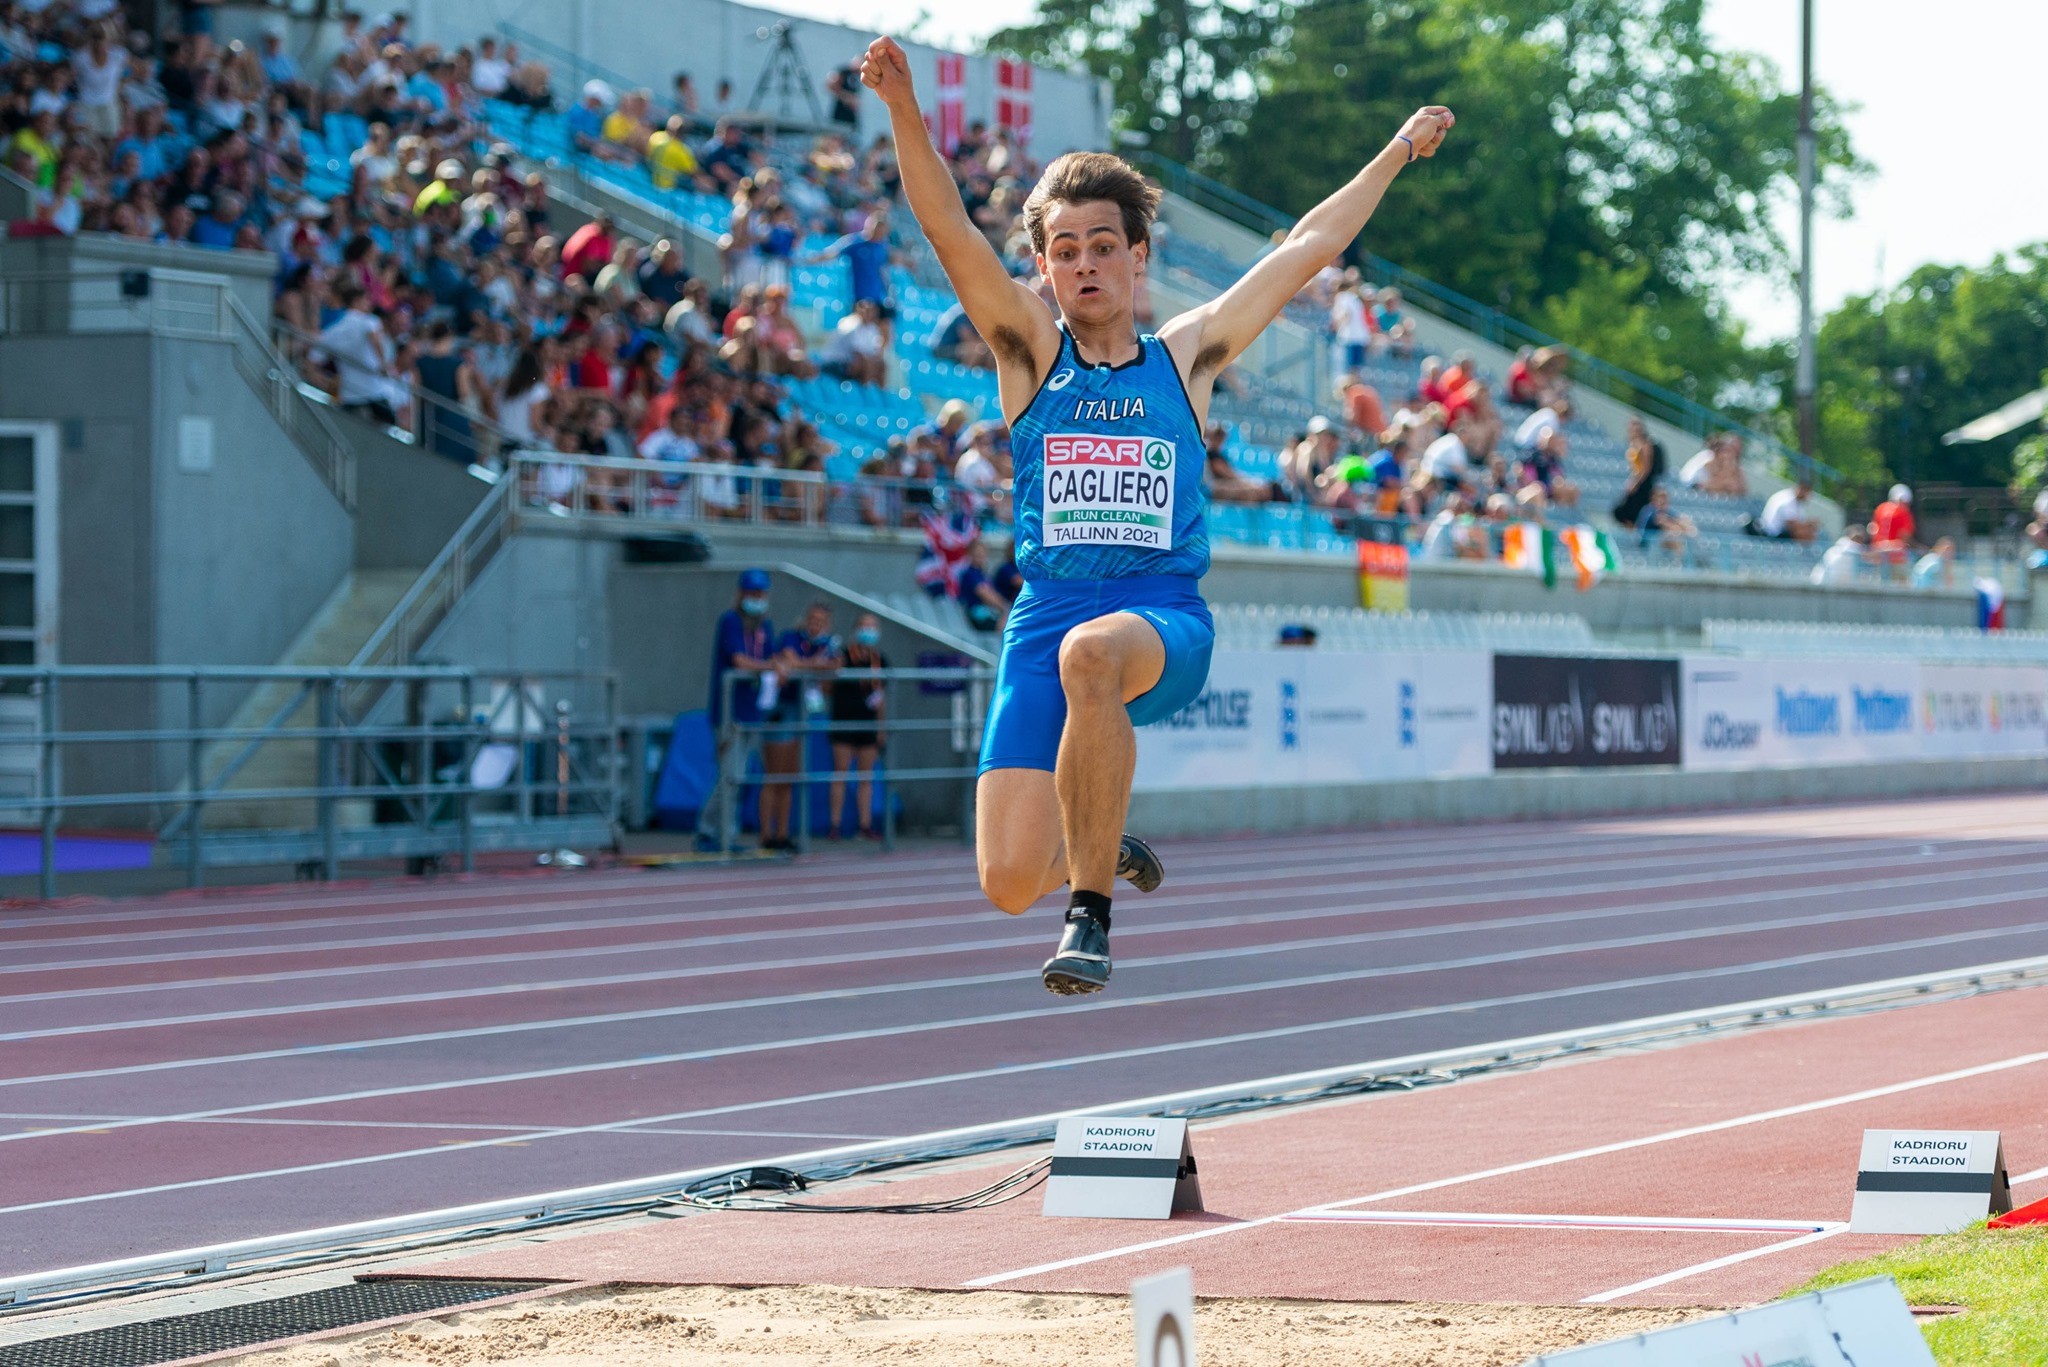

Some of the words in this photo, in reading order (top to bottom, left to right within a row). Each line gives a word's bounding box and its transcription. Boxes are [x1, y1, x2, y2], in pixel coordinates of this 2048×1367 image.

[1074, 397, 1145, 421] ITALIA
[1048, 440, 1140, 463] SPAR
[1048, 469, 1169, 509] CAGLIERO
[1073, 511, 1098, 521] RUN
[1054, 527, 1119, 542] TALLINN
[1122, 527, 1159, 545] 2021
[1086, 1127, 1156, 1137] KADRIORU
[1083, 1142, 1153, 1152] STAADION
[1893, 1140, 1967, 1151] KADRIORU
[1892, 1156, 1966, 1166] STAADION
